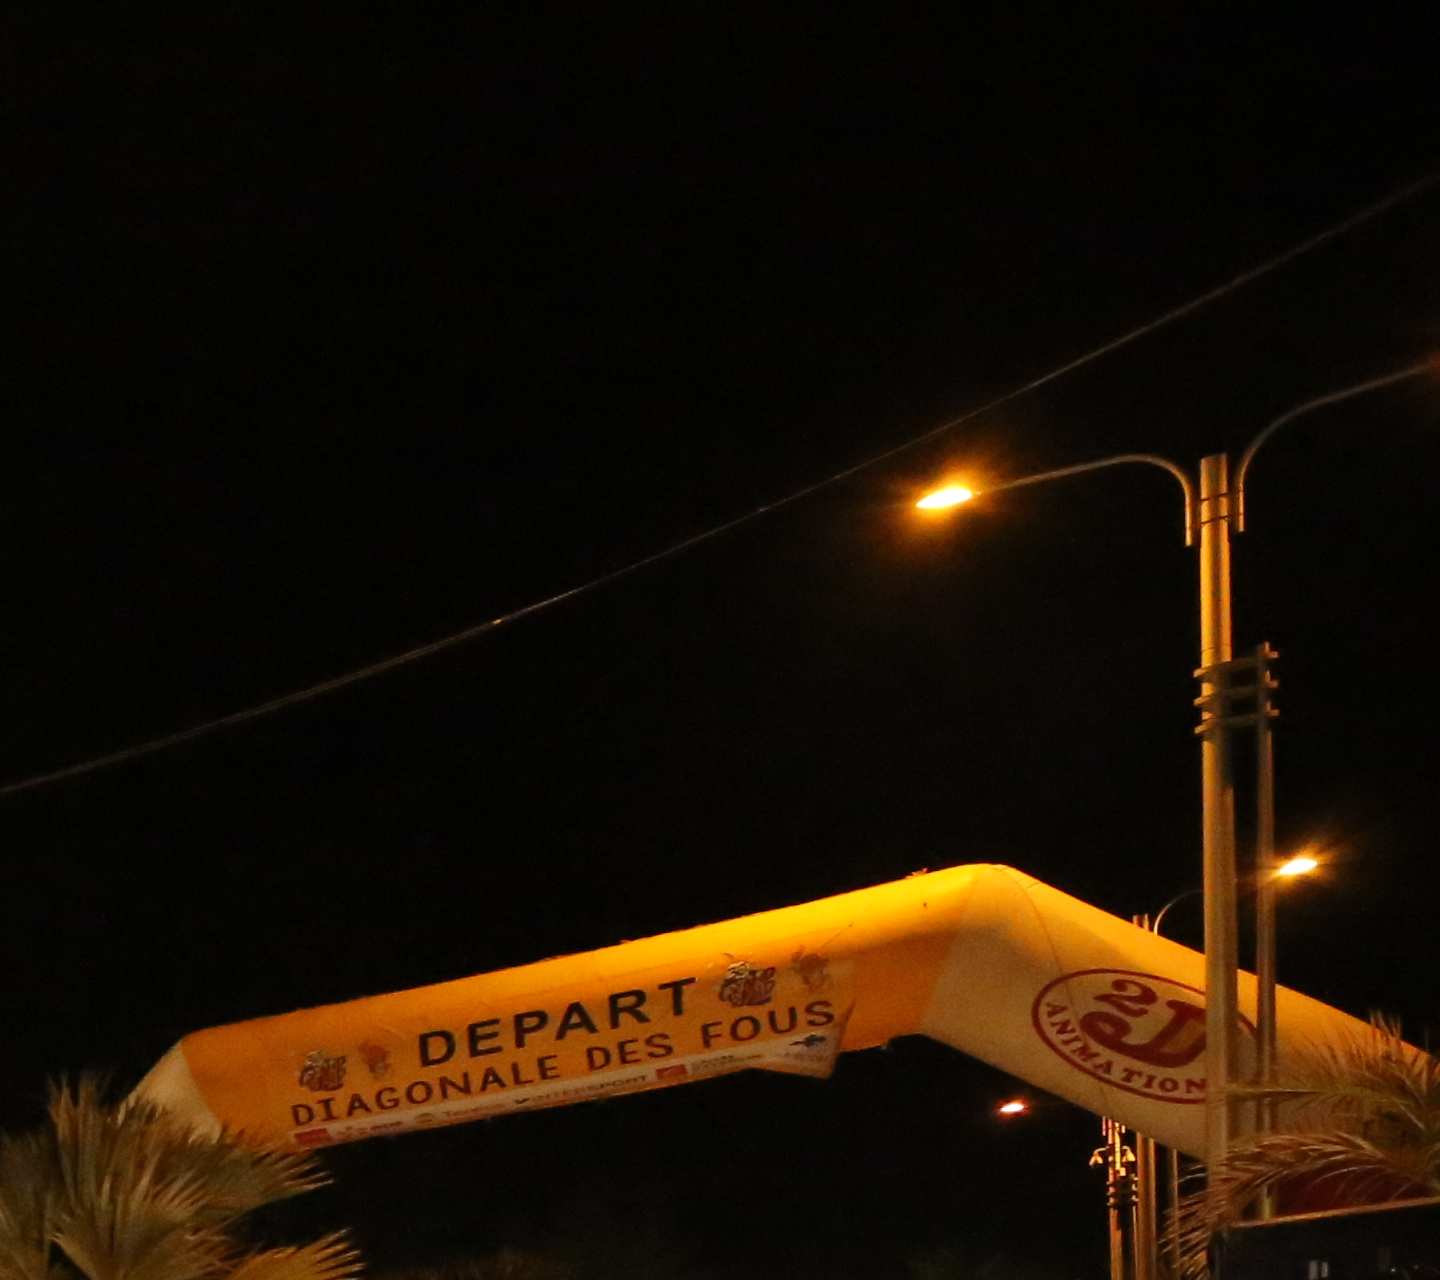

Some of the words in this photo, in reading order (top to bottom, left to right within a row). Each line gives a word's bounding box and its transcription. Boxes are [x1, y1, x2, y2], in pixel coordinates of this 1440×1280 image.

[291, 1055, 561, 1126] DIAGONALE
[586, 1033, 674, 1072] DES
[701, 1001, 835, 1049] FOUS
[418, 977, 697, 1068] DEPART
[1045, 1001, 1208, 1095] ANIMATION
